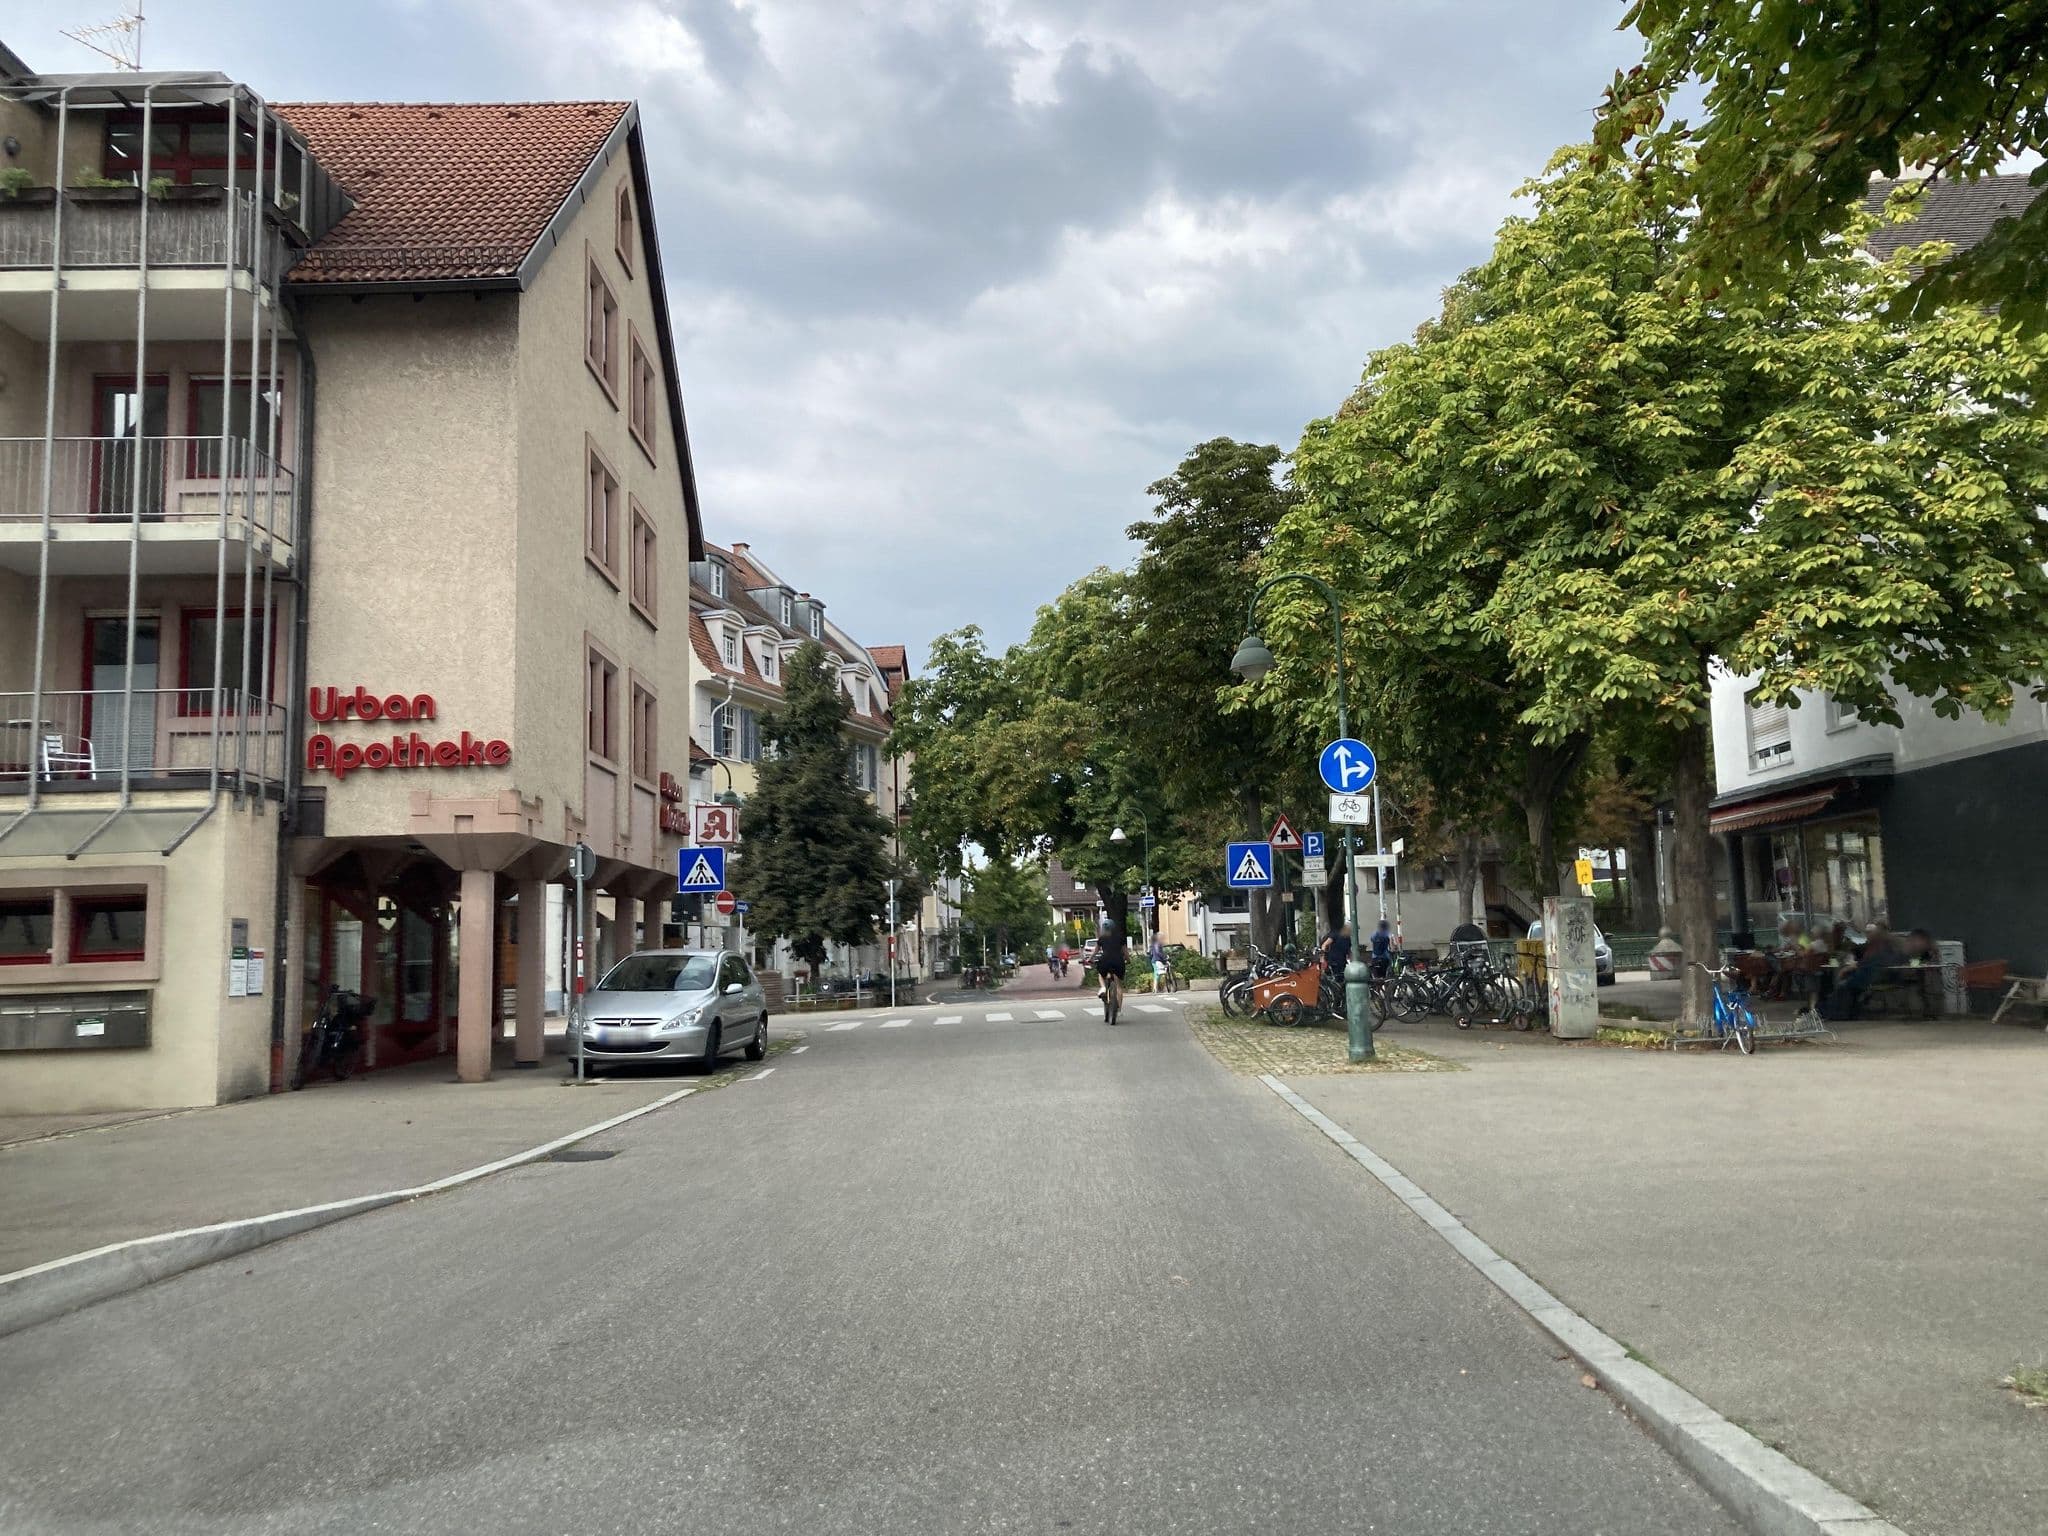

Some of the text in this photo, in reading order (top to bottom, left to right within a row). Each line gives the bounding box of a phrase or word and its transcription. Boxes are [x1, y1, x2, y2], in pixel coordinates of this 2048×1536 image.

[309, 686, 436, 721] Urban
[306, 731, 512, 779] Apotheke
[699, 809, 730, 840] A
[1343, 813, 1356, 821] frei
[1307, 836, 1319, 854] P
